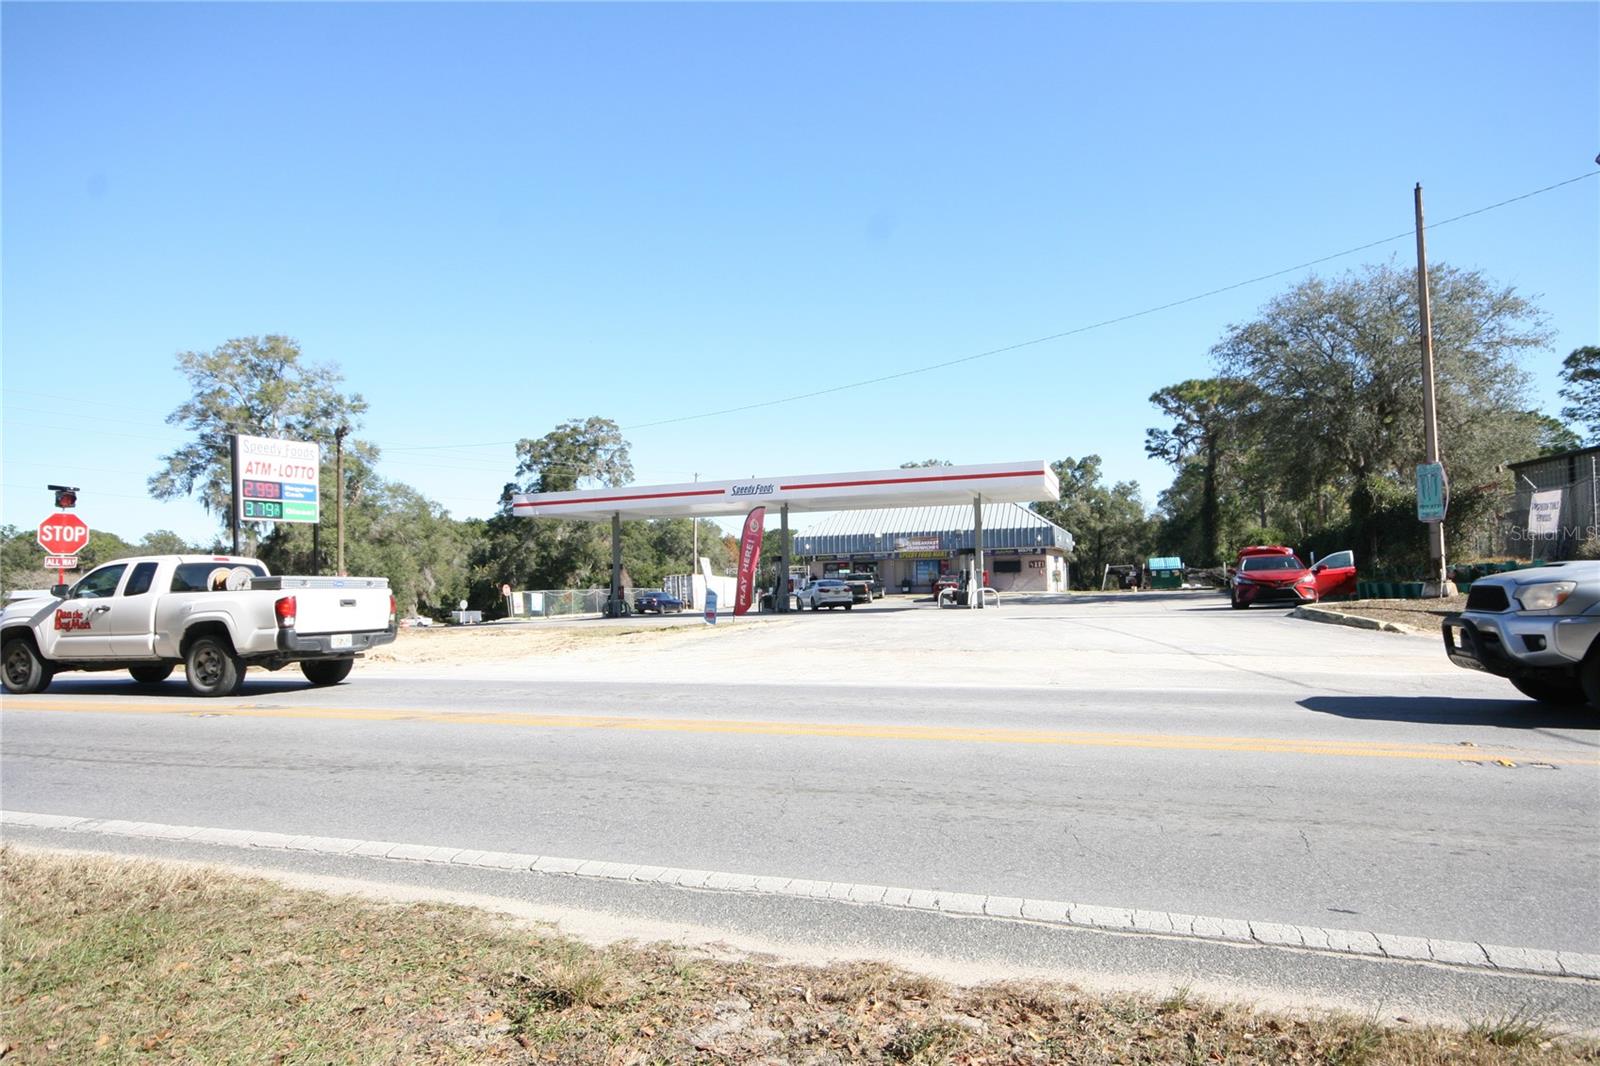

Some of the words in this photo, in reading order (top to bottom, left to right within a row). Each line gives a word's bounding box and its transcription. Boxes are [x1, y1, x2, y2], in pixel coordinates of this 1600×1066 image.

[243, 440, 282, 456] Speedy
[285, 444, 315, 460] Foods
[245, 461, 272, 476] ATM
[279, 465, 315, 480] LOTTO
[731, 485, 756, 496] Speedy
[755, 484, 774, 495] Foods
[41, 525, 86, 542] STOP
[740, 579, 748, 606] PLAY
